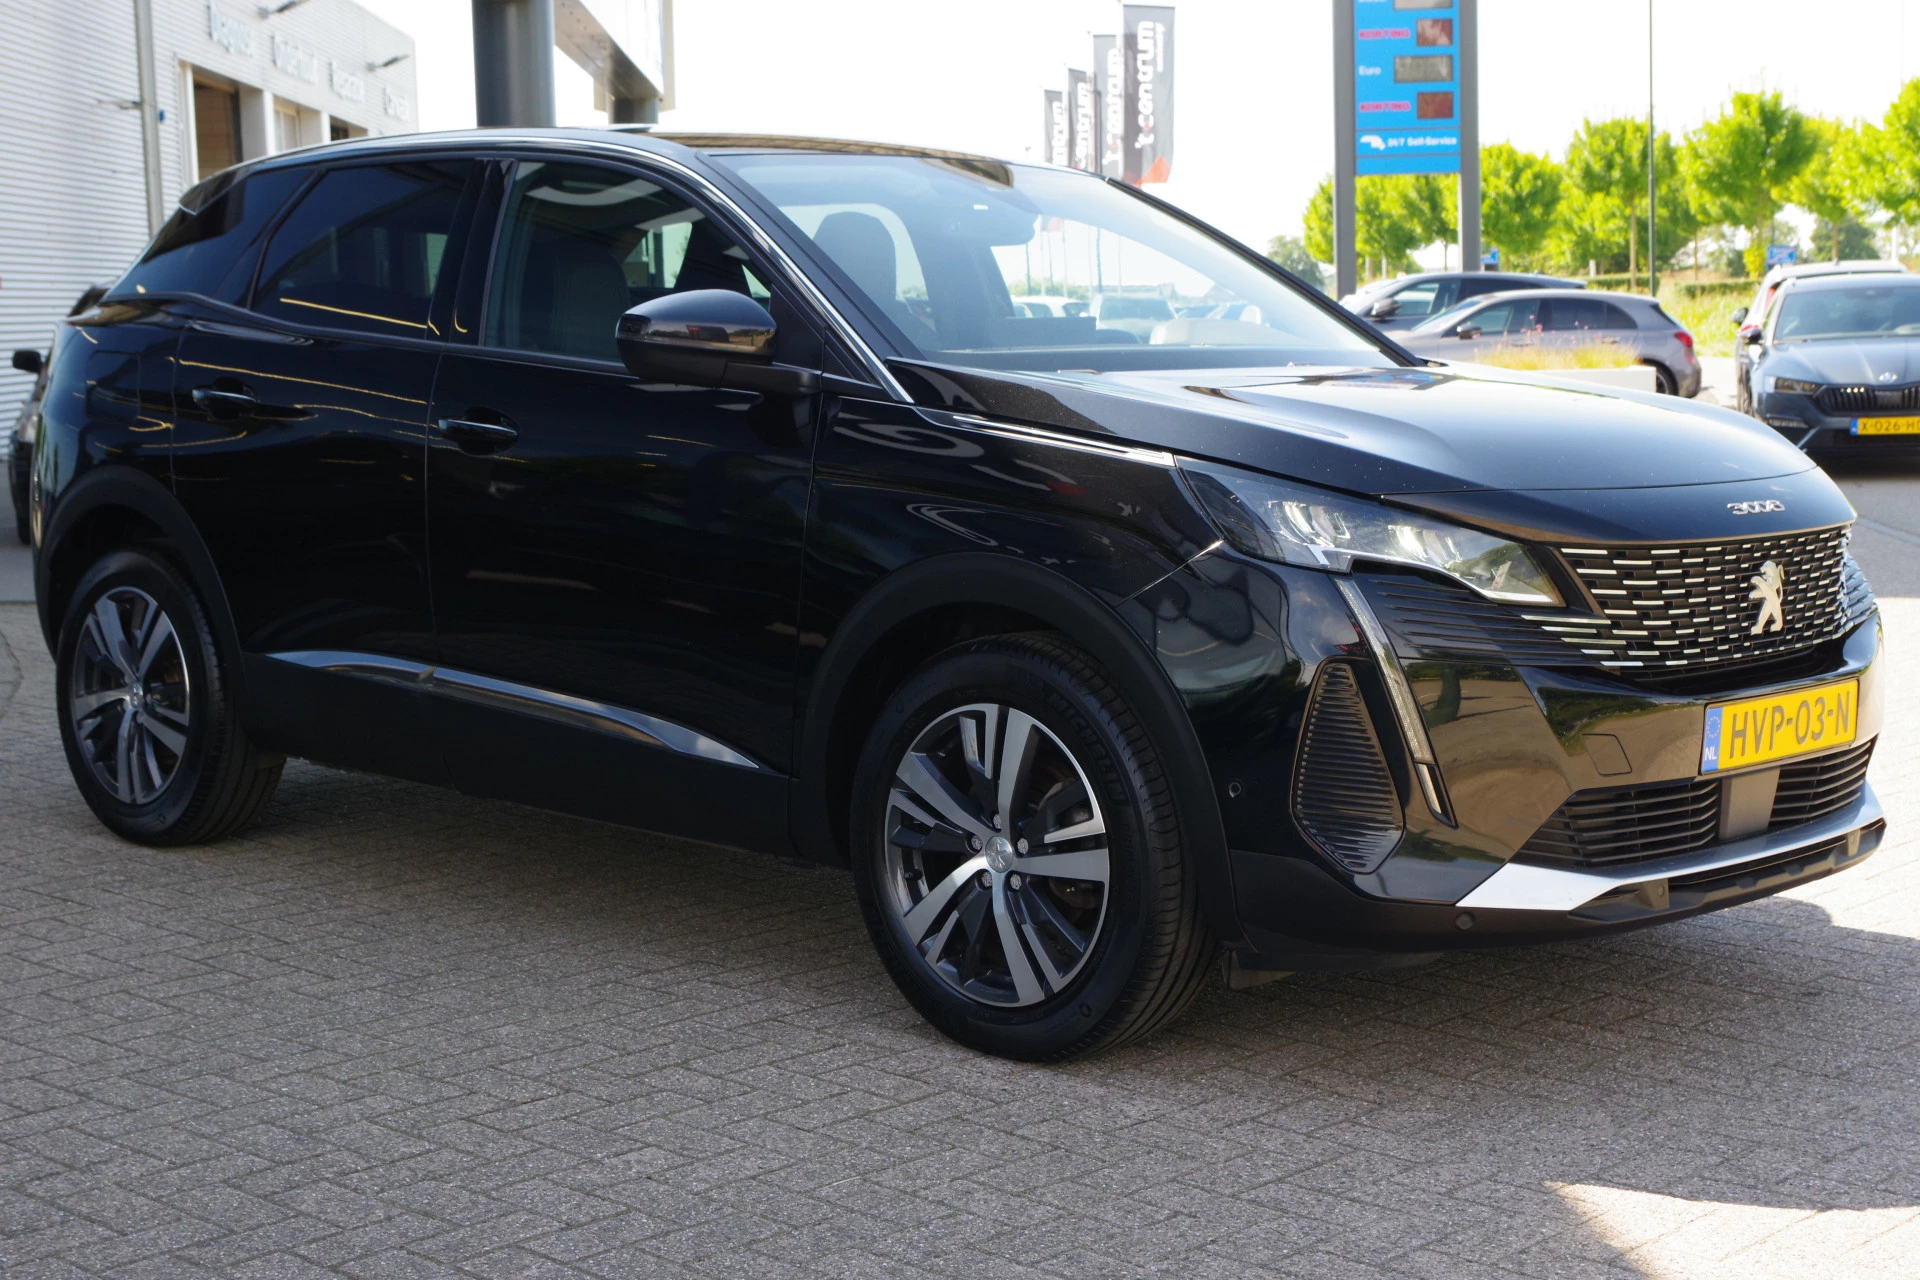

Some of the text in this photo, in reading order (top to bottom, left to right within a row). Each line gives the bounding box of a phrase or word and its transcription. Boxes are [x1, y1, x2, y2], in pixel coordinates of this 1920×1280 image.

[1137, 20, 1154, 129] centrum
[1359, 65, 1381, 76] Euro
[1727, 500, 1785, 515] 3008
[1048, 692, 1130, 807] MICHELIN
[1704, 691, 1851, 760] NL HVP-03-N
